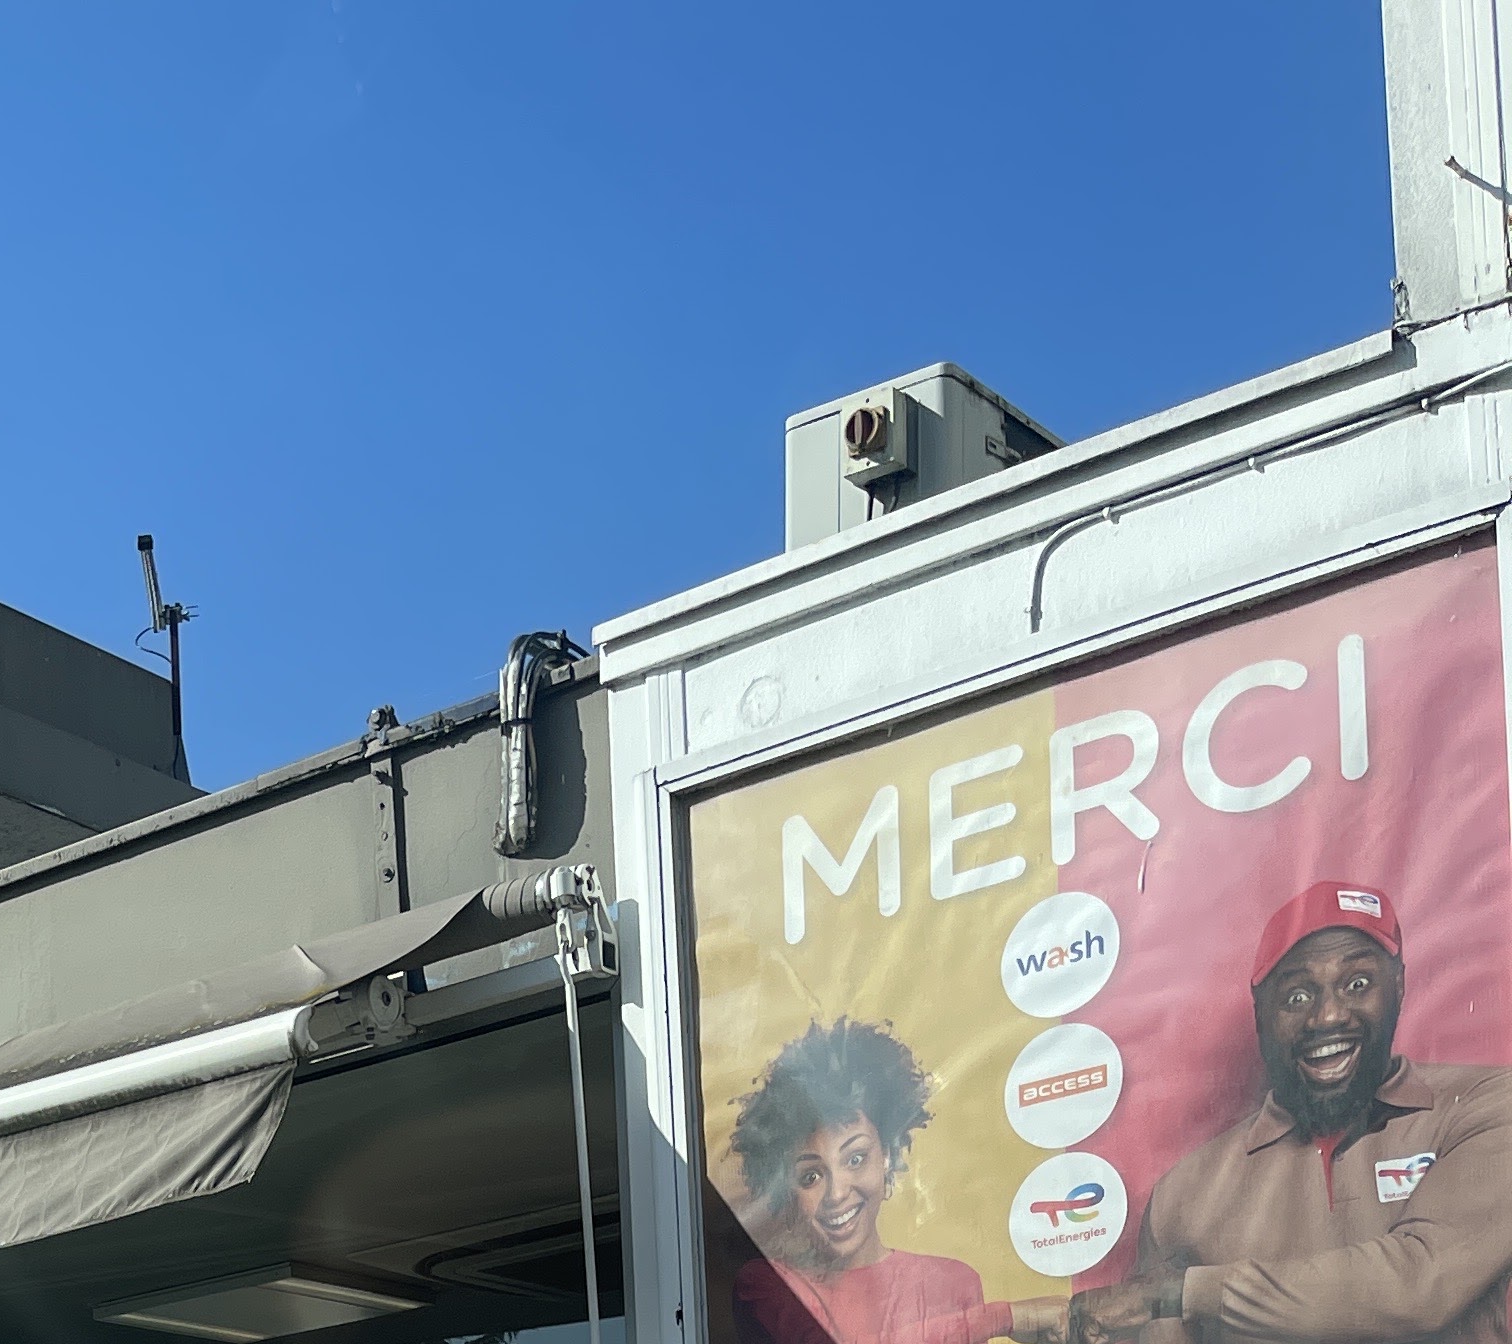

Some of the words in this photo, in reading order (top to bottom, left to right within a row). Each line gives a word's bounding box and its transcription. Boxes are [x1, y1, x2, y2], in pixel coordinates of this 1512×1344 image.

[781, 633, 1369, 945] MERCI
[1016, 929, 1105, 977] wash
[1031, 1227, 1107, 1250] TotalEnergies
